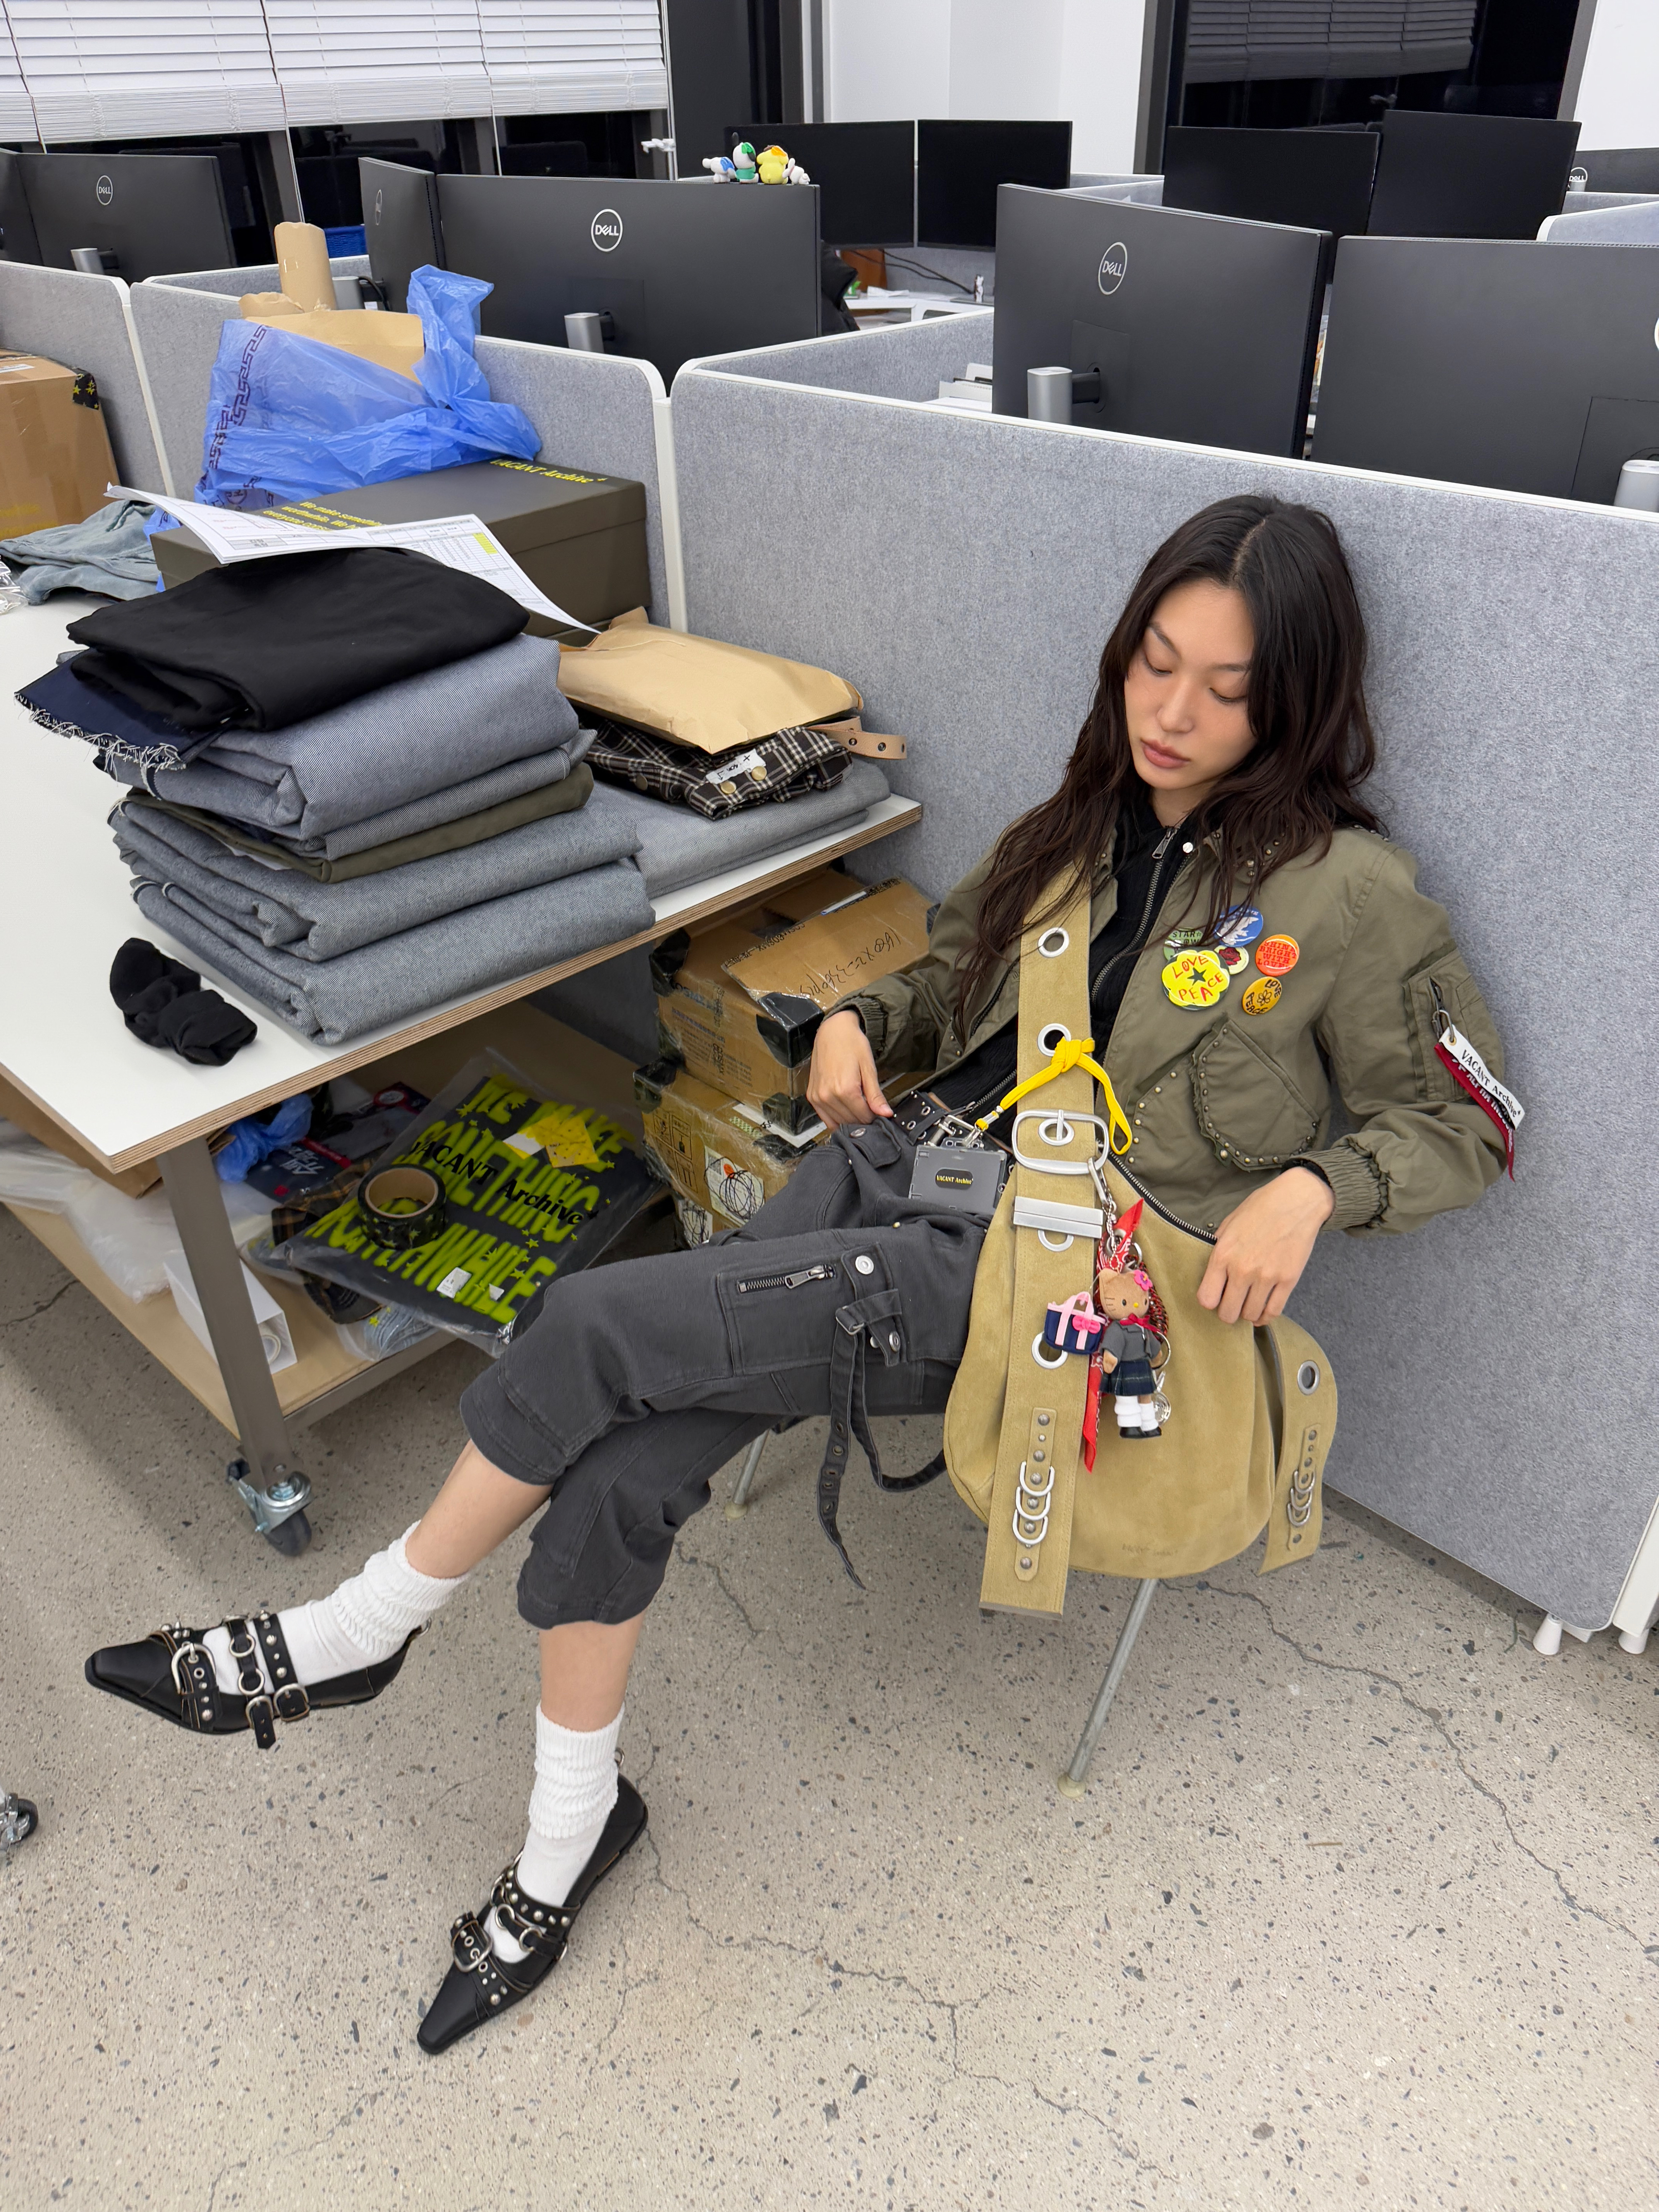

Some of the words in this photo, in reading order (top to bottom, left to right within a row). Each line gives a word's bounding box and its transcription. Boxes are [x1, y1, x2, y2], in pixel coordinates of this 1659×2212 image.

[595, 225, 619, 236] DELL
[1102, 260, 1122, 276] DELL
[1259, 946, 1296, 958] BRIGHT
[1263, 953, 1290, 963] WITH
[1172, 955, 1209, 979] LOVE
[1178, 972, 1223, 1001] PEACE
[1264, 979, 1281, 998] LOVE
[1462, 1049, 1490, 1086] VACANT
[1492, 1085, 1517, 1117] Archive
[497, 1178, 584, 1226] Archive
